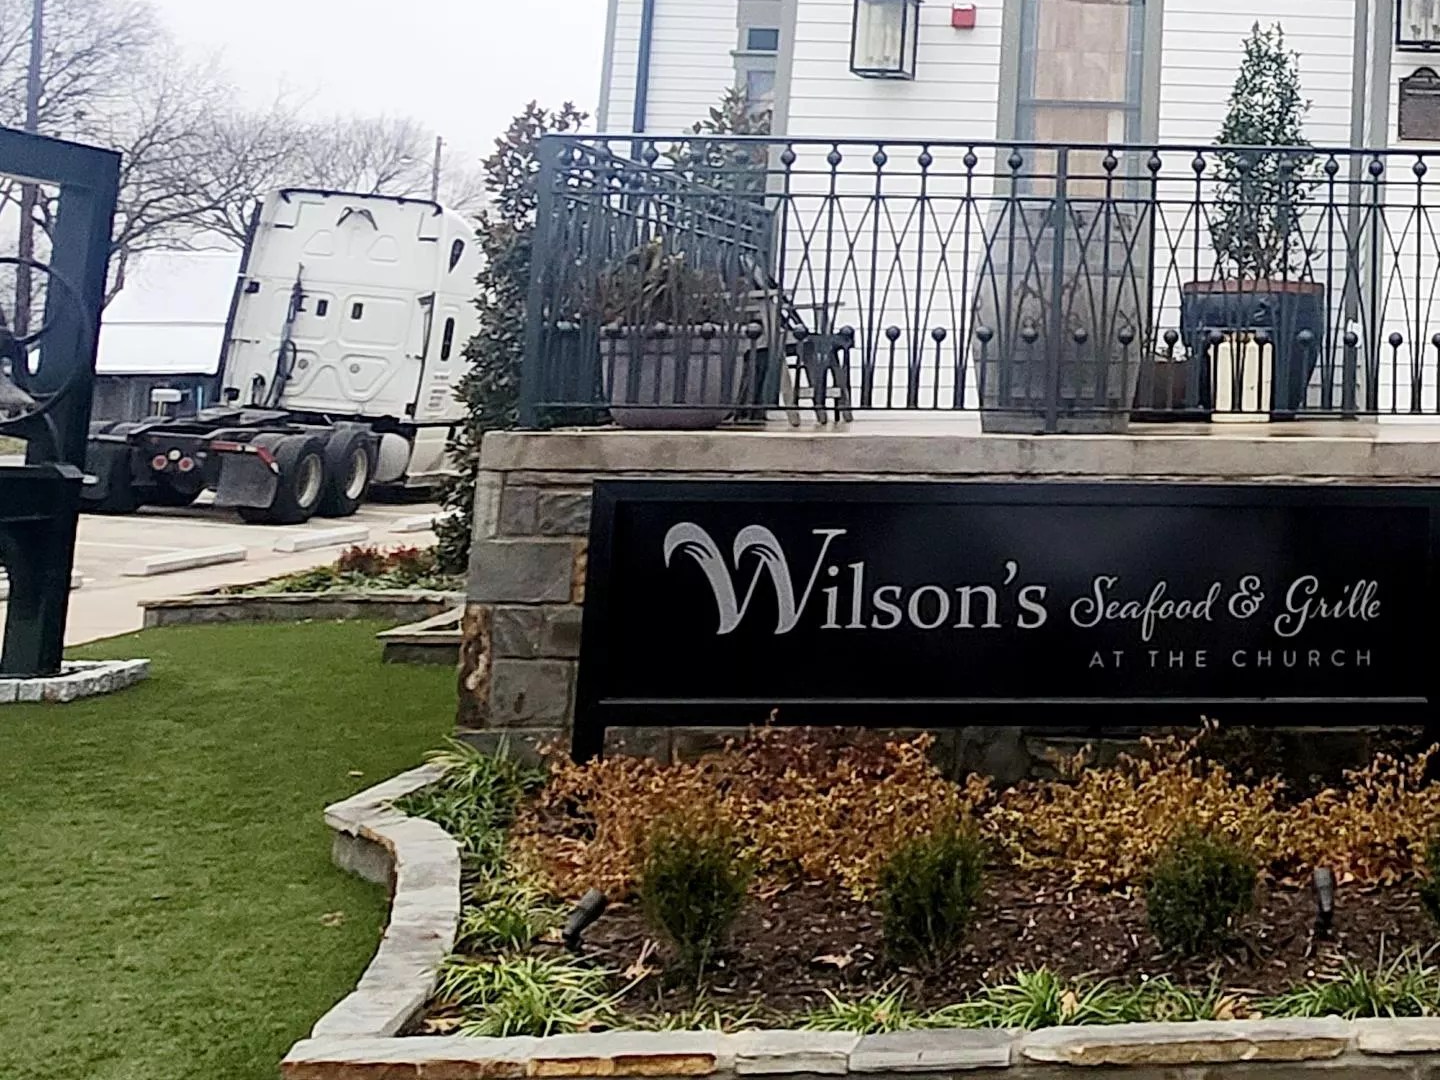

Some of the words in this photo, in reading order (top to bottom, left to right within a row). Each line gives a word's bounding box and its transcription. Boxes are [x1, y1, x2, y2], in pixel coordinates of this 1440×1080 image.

[663, 521, 1048, 635] Wilson's
[1070, 575, 1222, 642] Seafood
[1228, 575, 1265, 620] &
[1273, 575, 1382, 638] Grille
[1089, 650, 1124, 668] AT
[1148, 650, 1207, 668] THE
[1231, 649, 1372, 668] CHURCH
